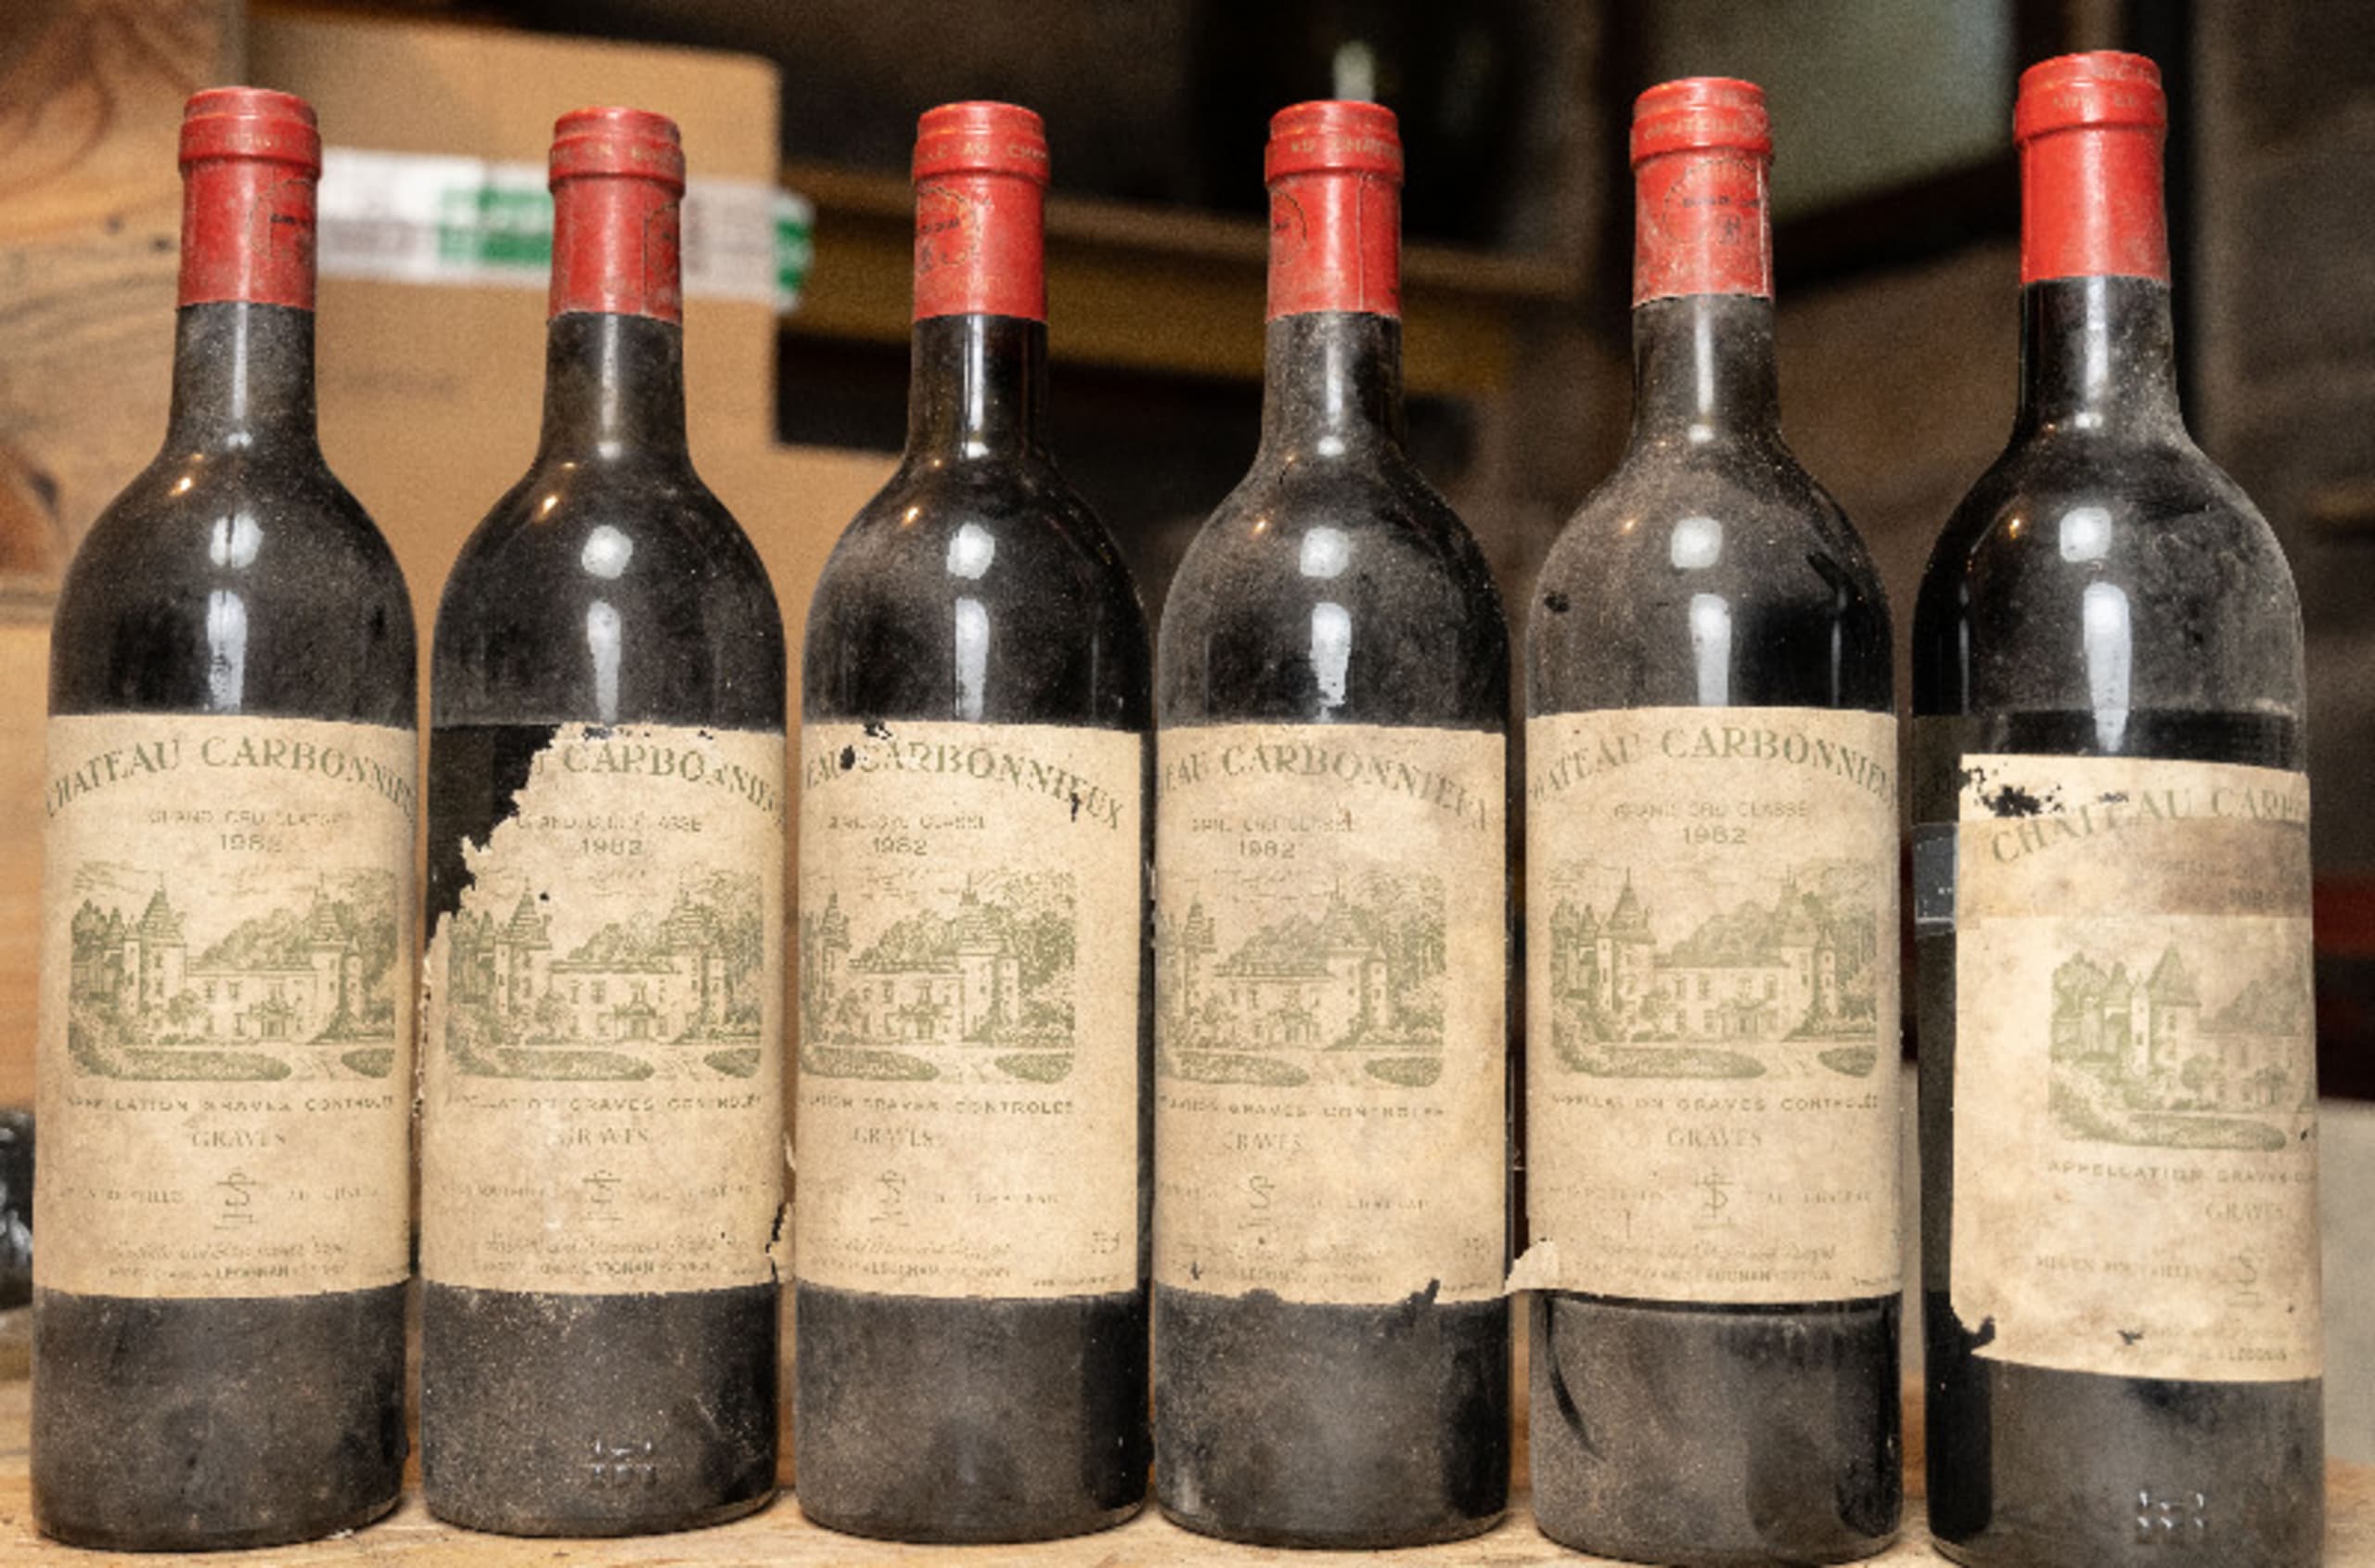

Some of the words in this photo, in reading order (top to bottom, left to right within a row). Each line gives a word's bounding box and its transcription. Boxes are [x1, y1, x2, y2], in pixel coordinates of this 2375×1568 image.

[856, 739, 1124, 831] CARBONNIEUX
[1683, 825, 1748, 844] 1982
[1991, 789, 2192, 864] CHATEAU
[873, 836, 928, 855] 1982
[1239, 840, 1295, 859] 1982
[1675, 1098, 1766, 1112] GRAVES
[191, 1130, 287, 1148] GRAVES
[1666, 1126, 1764, 1148] GRAVES
[2047, 1160, 2204, 1184] APPELLATION
